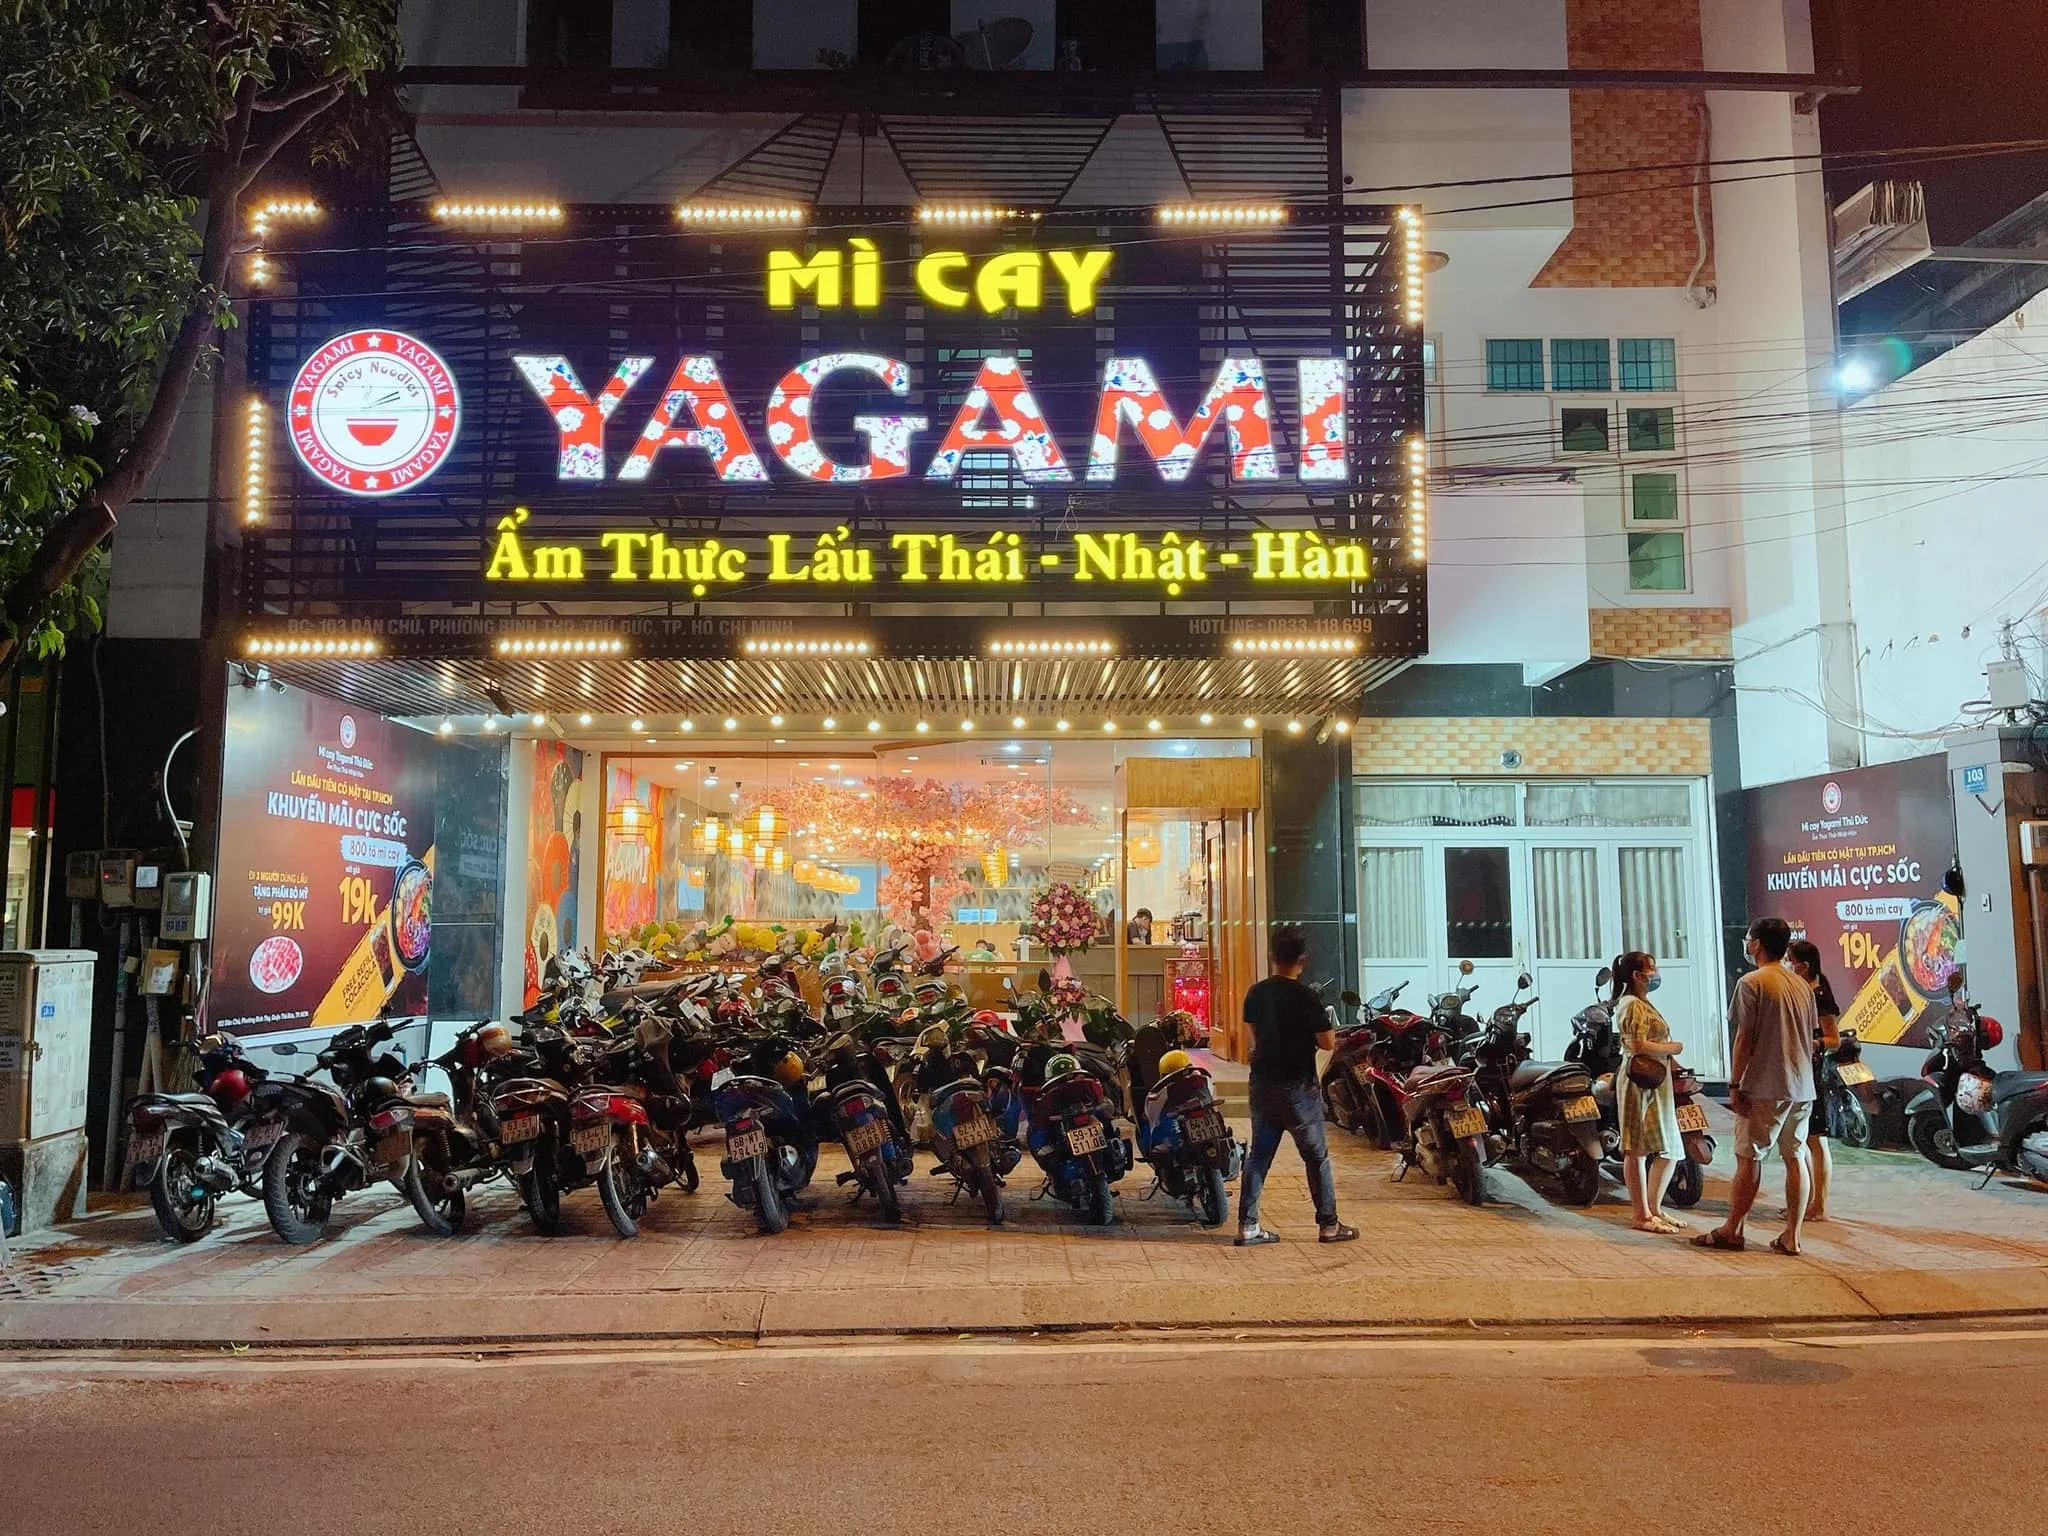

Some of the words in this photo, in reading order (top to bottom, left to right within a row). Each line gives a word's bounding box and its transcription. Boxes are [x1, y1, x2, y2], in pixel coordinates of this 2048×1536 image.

[768, 237, 880, 308] MÌ
[915, 250, 1113, 316] CAY
[298, 338, 355, 393] YAGAMI
[326, 366, 363, 399] Spicy
[370, 361, 420, 398] Noodles
[395, 338, 450, 395] YAGAMI
[510, 352, 1349, 483] YAGAMI
[296, 427, 352, 485] YAGAMI
[391, 430, 449, 485] YAGAMI
[486, 507, 585, 580] Ẩm
[601, 532, 748, 597] Thực
[767, 525, 874, 583] Lẩu
[891, 531, 1024, 582] Thái
[1074, 533, 1207, 596] Nhật
[1252, 530, 1368, 580] Hàn
[1966, 768, 1984, 783] 103
[267, 791, 326, 823] KHUYẾN
[329, 800, 353, 828] MÃI
[355, 808, 381, 837] CỰC
[383, 809, 408, 837] SỐC
[350, 840, 367, 857] 800
[388, 850, 400, 864] cay
[1827, 848, 1838, 860] CÓ
[1767, 865, 1818, 891] KHUYẾN
[1821, 863, 1846, 888] MÃI
[1850, 864, 1883, 891] CỰC
[1887, 856, 1921, 884] SỐC
[272, 901, 305, 930] 99K
[338, 876, 378, 925] 19k
[1845, 903, 1863, 917] 800
[1876, 903, 1887, 915] mì
[1888, 904, 1903, 916] cay
[1838, 931, 1881, 969] 19k
[342, 974, 357, 999] FREE
[345, 960, 377, 1009] COCACOLA
[1855, 1004, 1869, 1025] FREE
[1859, 994, 1889, 1033] COCACOLA
